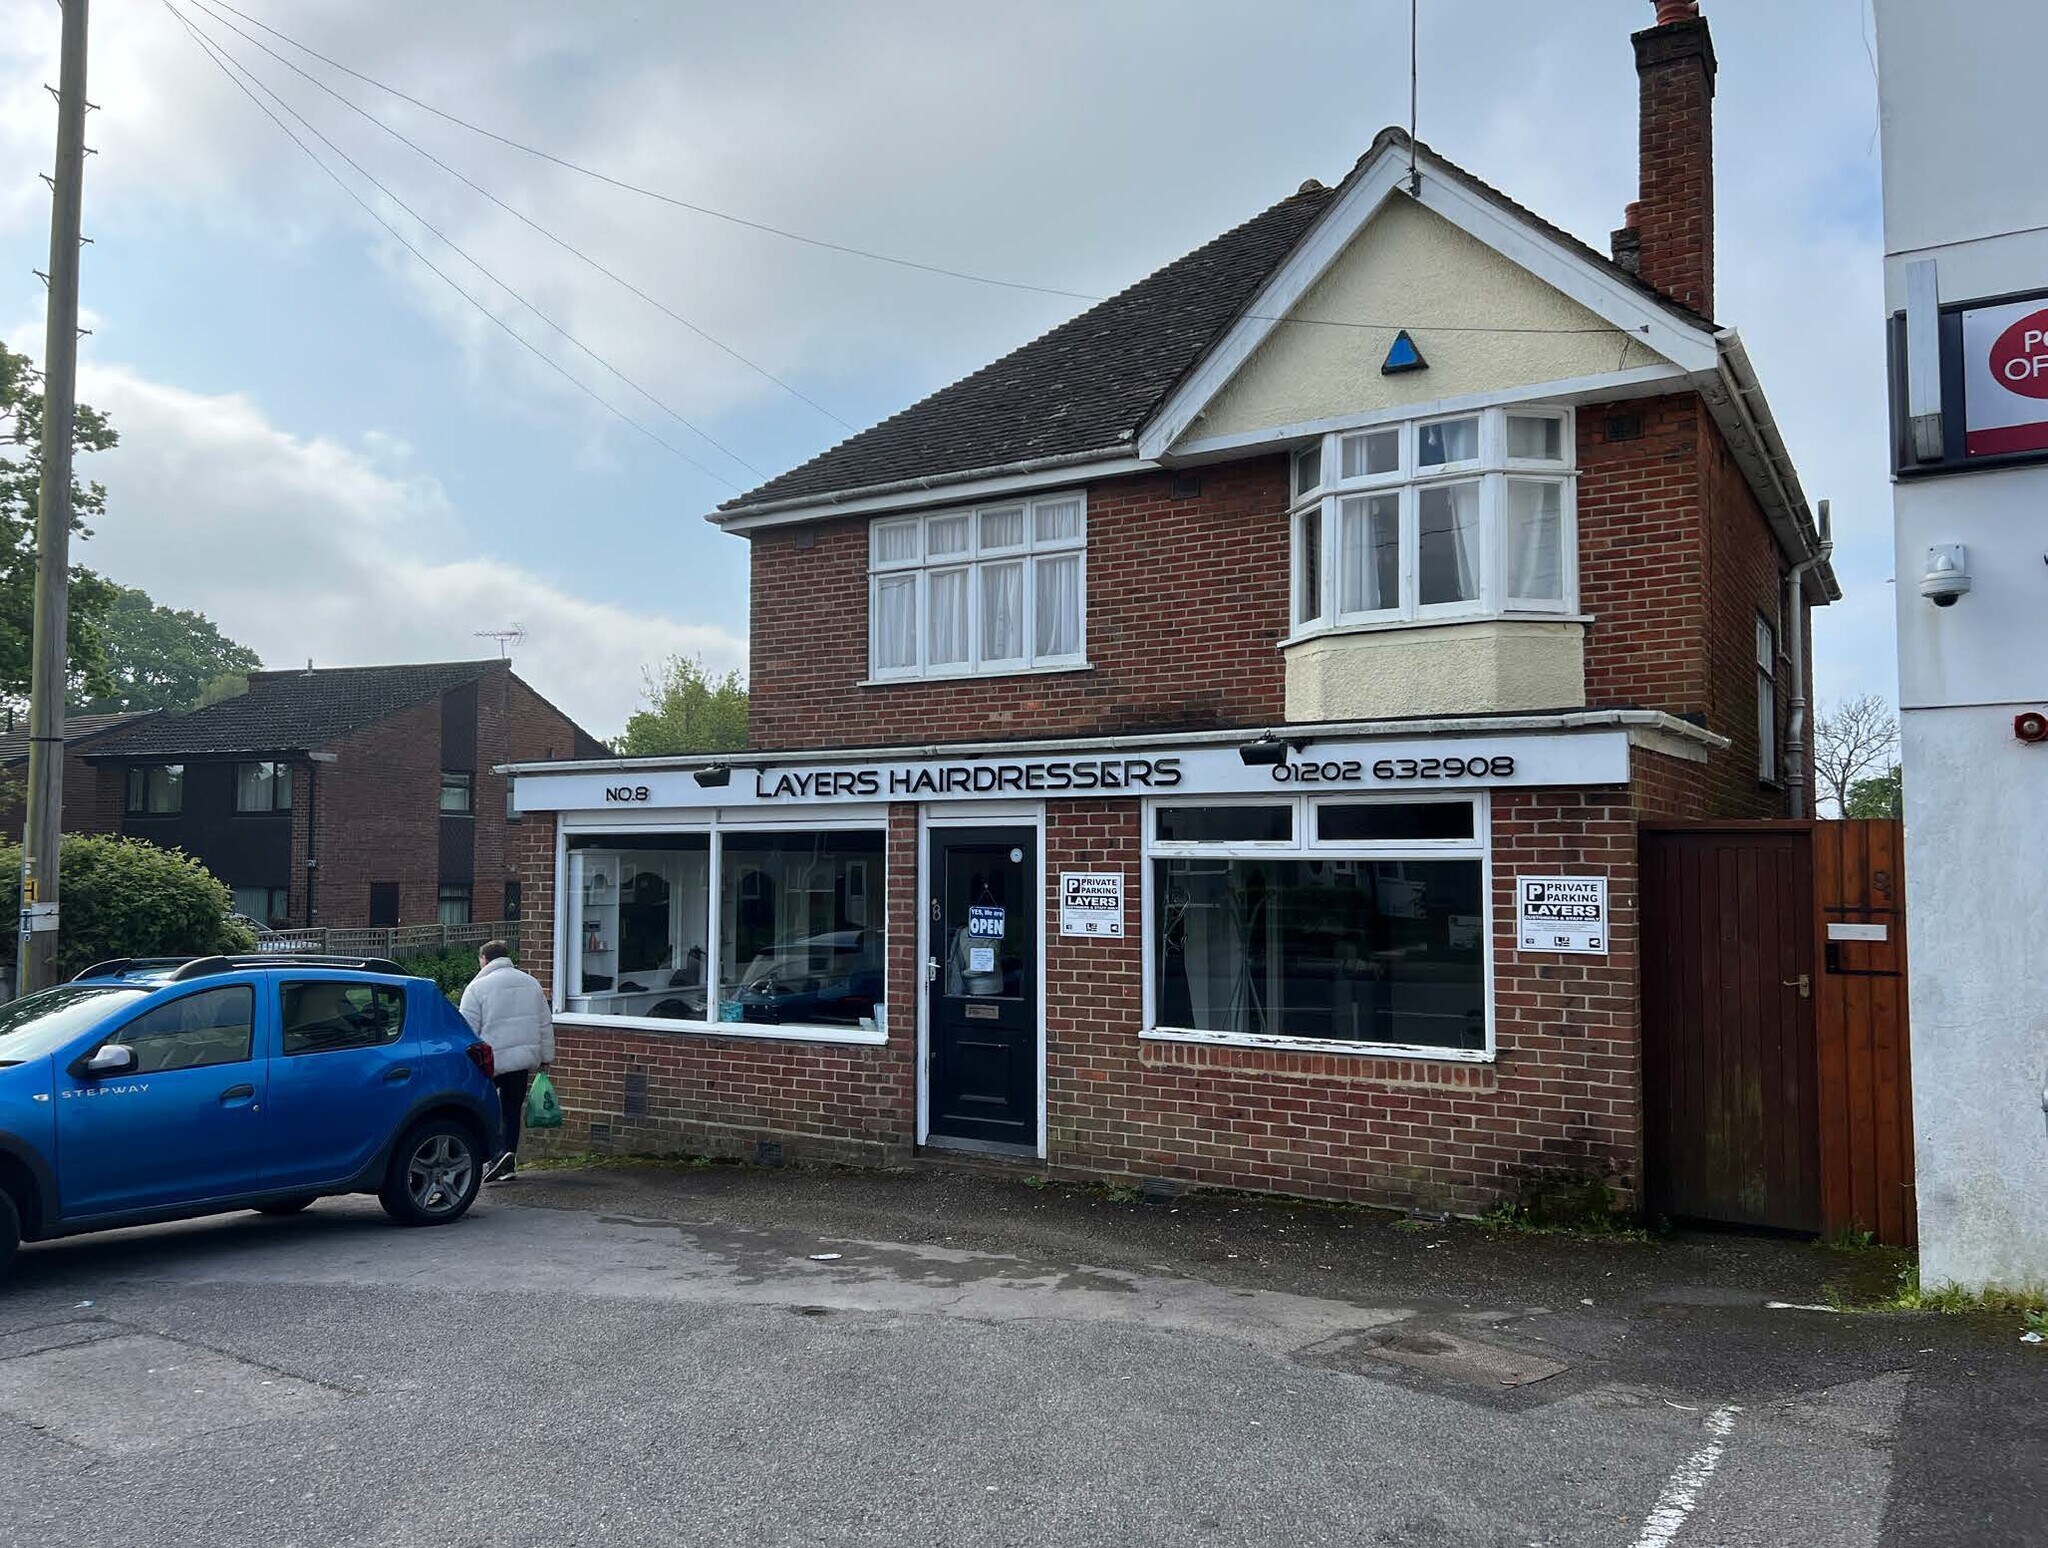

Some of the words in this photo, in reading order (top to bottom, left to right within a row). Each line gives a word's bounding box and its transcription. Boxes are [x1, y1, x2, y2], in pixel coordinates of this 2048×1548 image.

[2024, 330, 2048, 353] P
[1271, 760, 1361, 782] 01202
[1372, 755, 1515, 780] 632908
[755, 770, 880, 798] LAYERS
[889, 758, 1182, 794] HAIRDRESSERS
[605, 786, 649, 802] NO.8
[1547, 883, 1598, 892] PRIVATE
[1067, 896, 1117, 906] LAYERS
[1547, 893, 1598, 903] PARKING
[1527, 905, 1597, 916] LAYERS
[970, 918, 1003, 934] OPEN
[61, 1084, 150, 1099] STEPWAY
